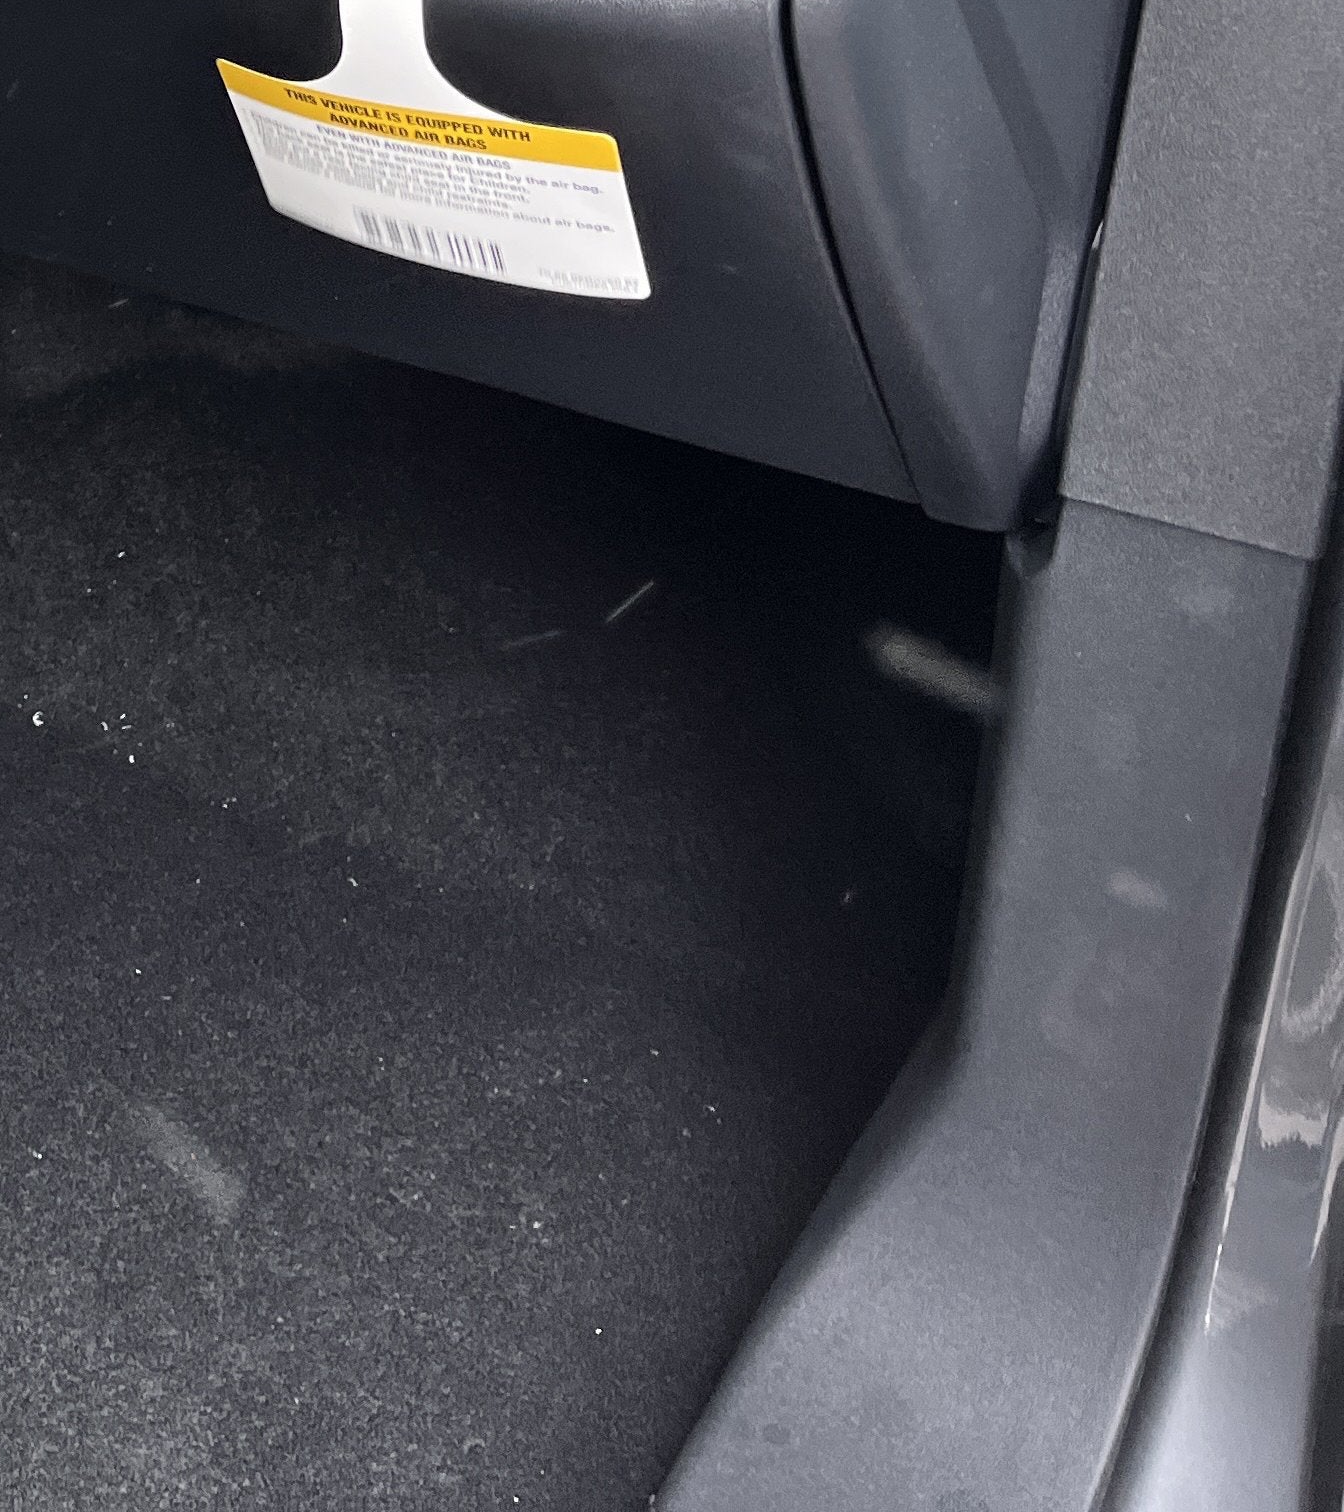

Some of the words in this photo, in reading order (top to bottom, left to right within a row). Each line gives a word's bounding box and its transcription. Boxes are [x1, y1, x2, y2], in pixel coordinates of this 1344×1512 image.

[284, 88, 317, 105] THIS
[320, 97, 382, 119] VEHICLE
[386, 111, 401, 123] IS
[407, 114, 483, 135] EQUIPPED
[488, 126, 531, 142] WITH
[330, 113, 408, 138] ADVANCED
[415, 130, 441, 144] AIR
[445, 134, 487, 150] BAGS
[316, 124, 346, 139] EVEN
[350, 132, 381, 148] WITH
[384, 140, 448, 160] ADVANCED
[452, 152, 473, 165] AIR
[476, 155, 512, 170] BAGS
[526, 175, 547, 186] the
[551, 178, 569, 189] air
